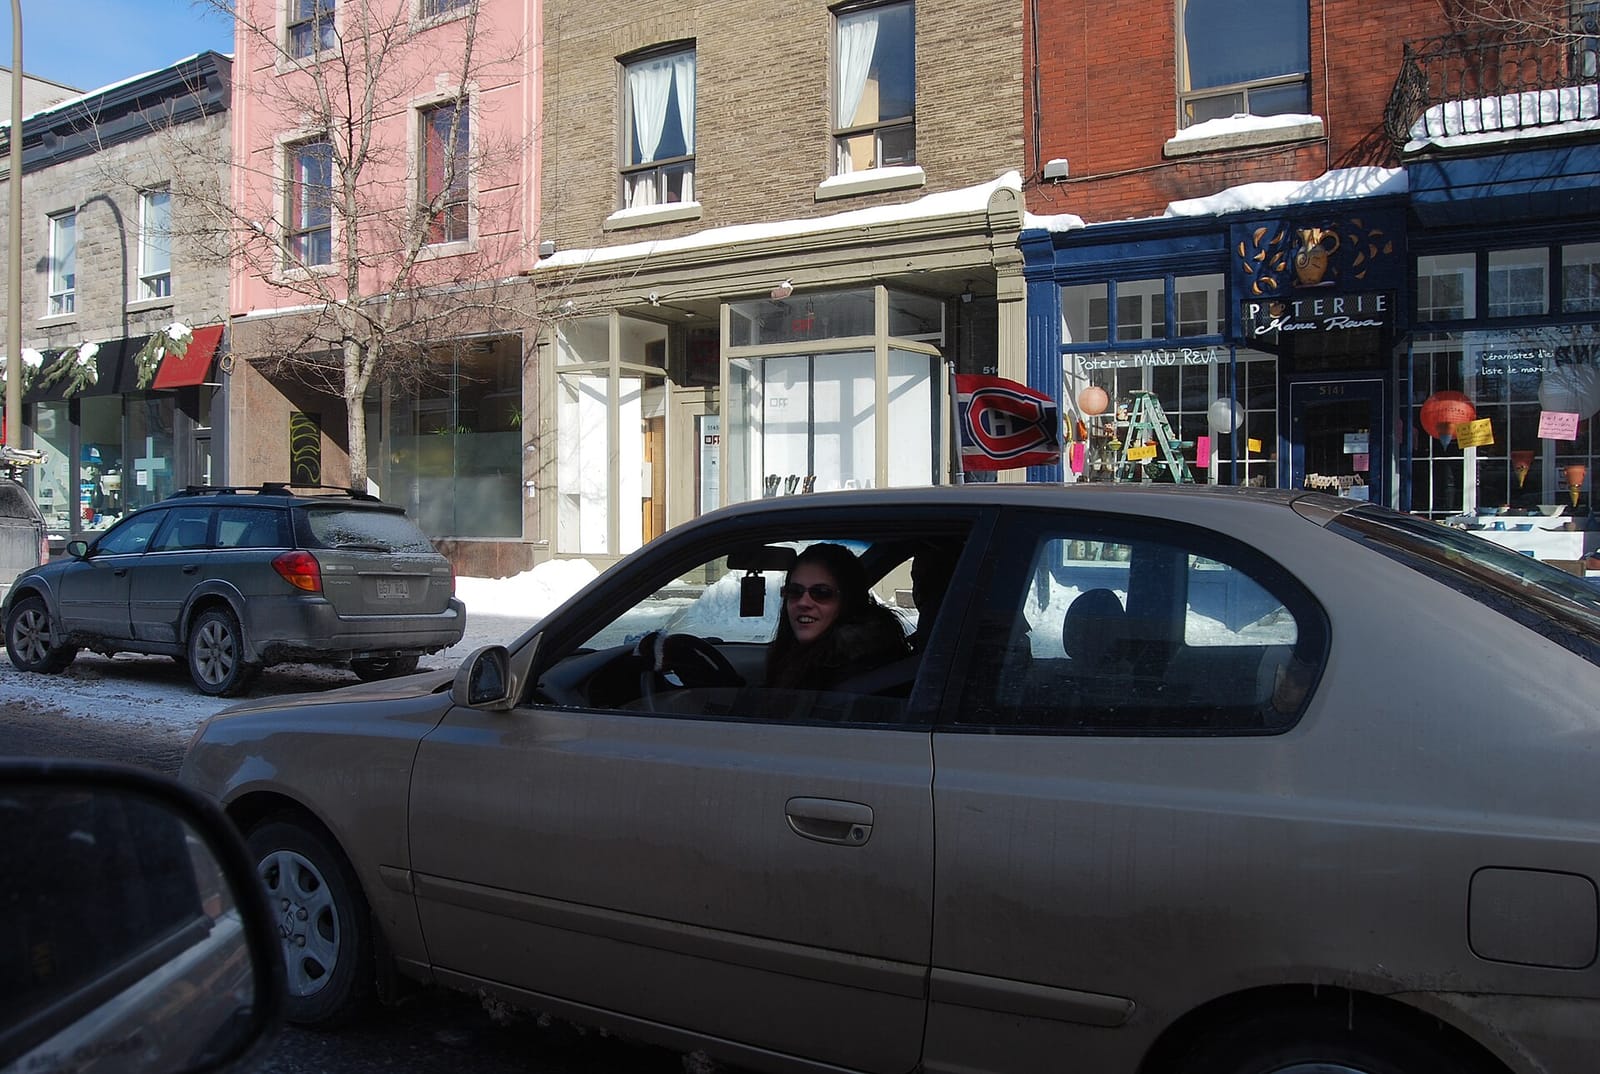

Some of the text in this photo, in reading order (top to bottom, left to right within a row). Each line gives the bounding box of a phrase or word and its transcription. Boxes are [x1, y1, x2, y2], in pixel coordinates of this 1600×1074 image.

[1075, 348, 1218, 370] Poterie MANU REVA
[983, 366, 999, 375] 51
[1507, 365, 1518, 374] de
[1320, 385, 1345, 396] 5141
